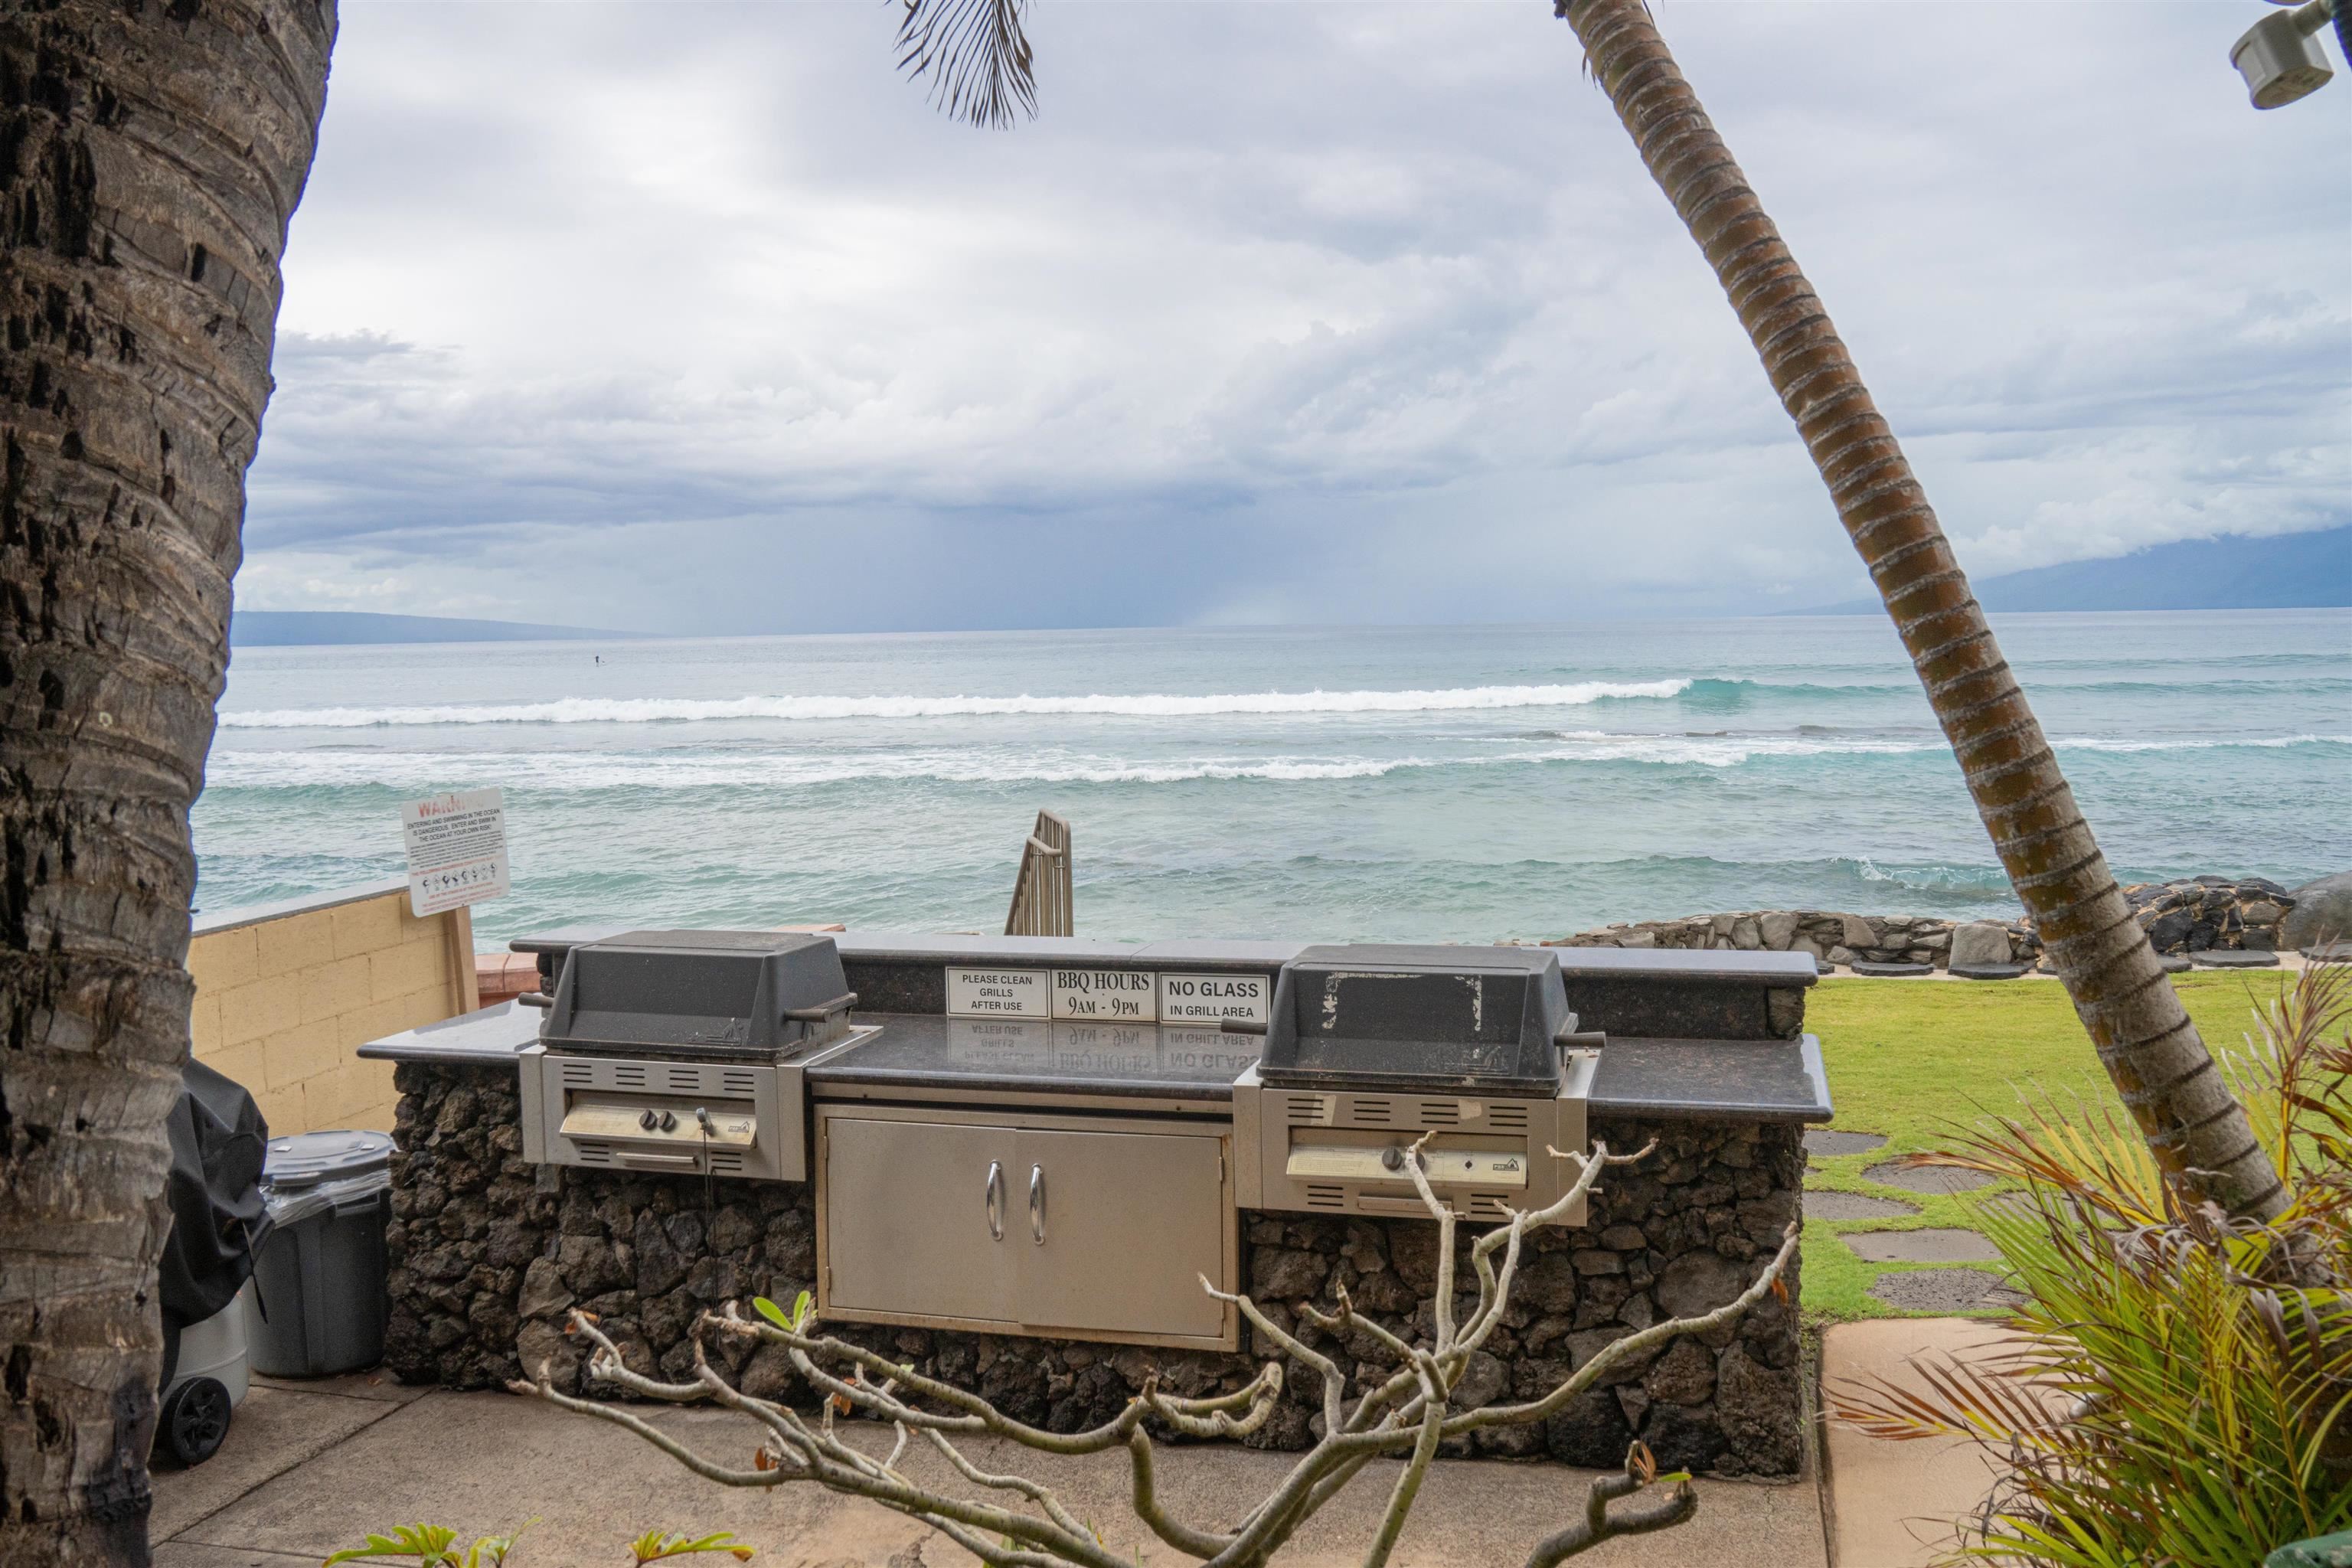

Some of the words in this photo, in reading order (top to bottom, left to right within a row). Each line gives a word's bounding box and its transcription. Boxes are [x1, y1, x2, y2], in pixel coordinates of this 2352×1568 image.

[407, 820, 430, 829] ENTERING
[443, 813, 467, 822] SWIMMING
[430, 832, 446, 841] OCEAN
[962, 975, 998, 984] PLEASE
[1001, 976, 1032, 985] CLEAN
[1057, 972, 1089, 993] BBQ
[1094, 973, 1149, 991] HOURS
[980, 988, 1013, 998] GRILLS
[1169, 982, 1194, 995] NO
[1200, 982, 1259, 998] GLASS
[972, 1001, 1001, 1010] AFTER
[1004, 1001, 1022, 1011] USE
[1068, 996, 1096, 1015] 9AM
[1112, 998, 1139, 1017] 9PM
[1171, 1005, 1182, 1015] IN
[1185, 1005, 1220, 1017] GRILL
[1221, 1007, 1254, 1018] AREA
